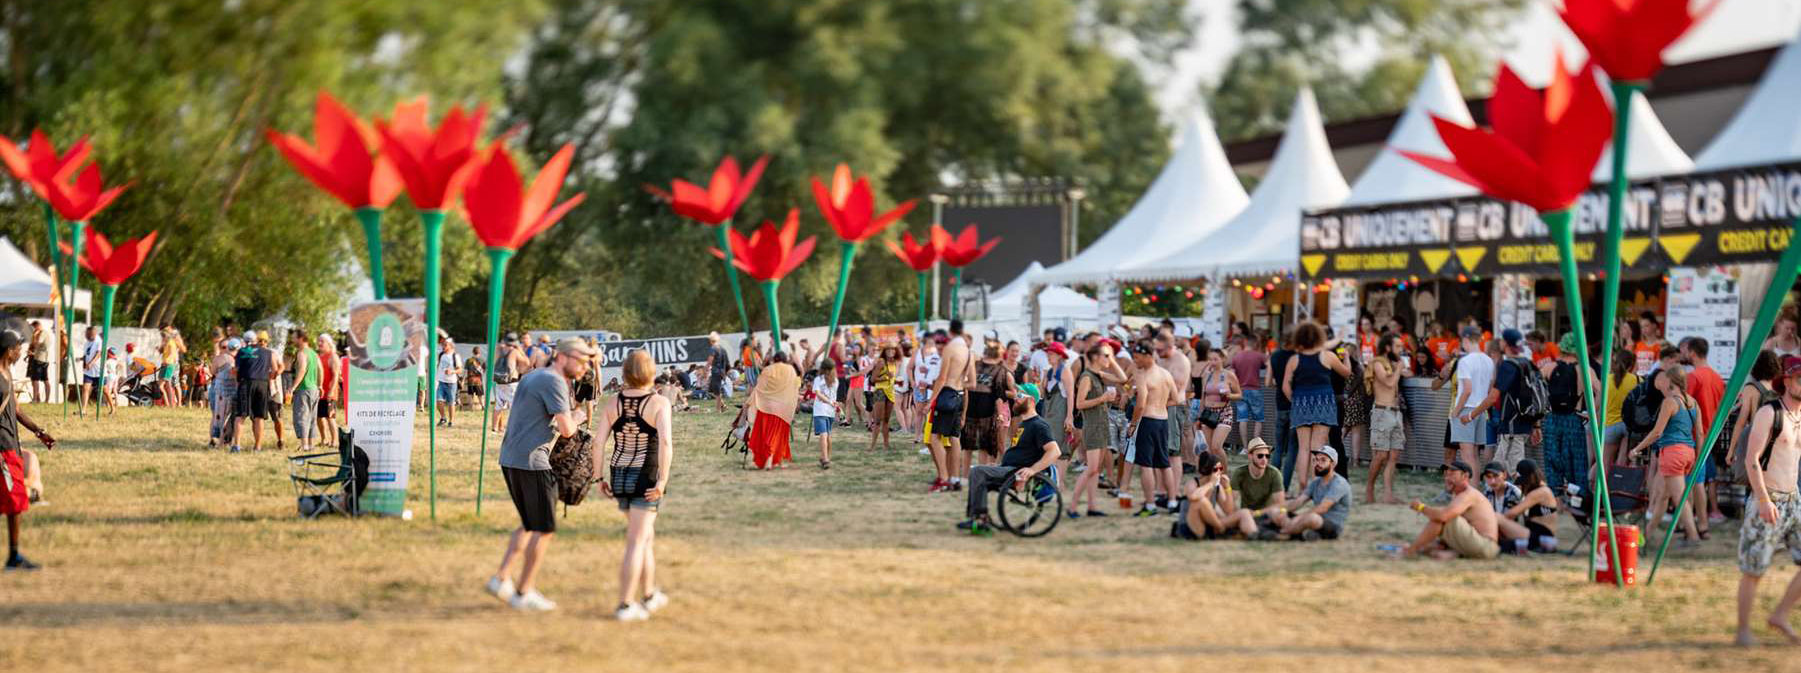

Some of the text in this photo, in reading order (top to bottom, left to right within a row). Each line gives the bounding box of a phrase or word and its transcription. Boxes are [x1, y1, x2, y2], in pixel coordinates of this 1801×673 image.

[1478, 201, 1505, 240] CB
[1687, 181, 1726, 227] CB
[1342, 207, 1454, 248] UNIQUEMENT
[1718, 229, 1767, 253] CREDIT
[1498, 245, 1534, 264] CREDIT
